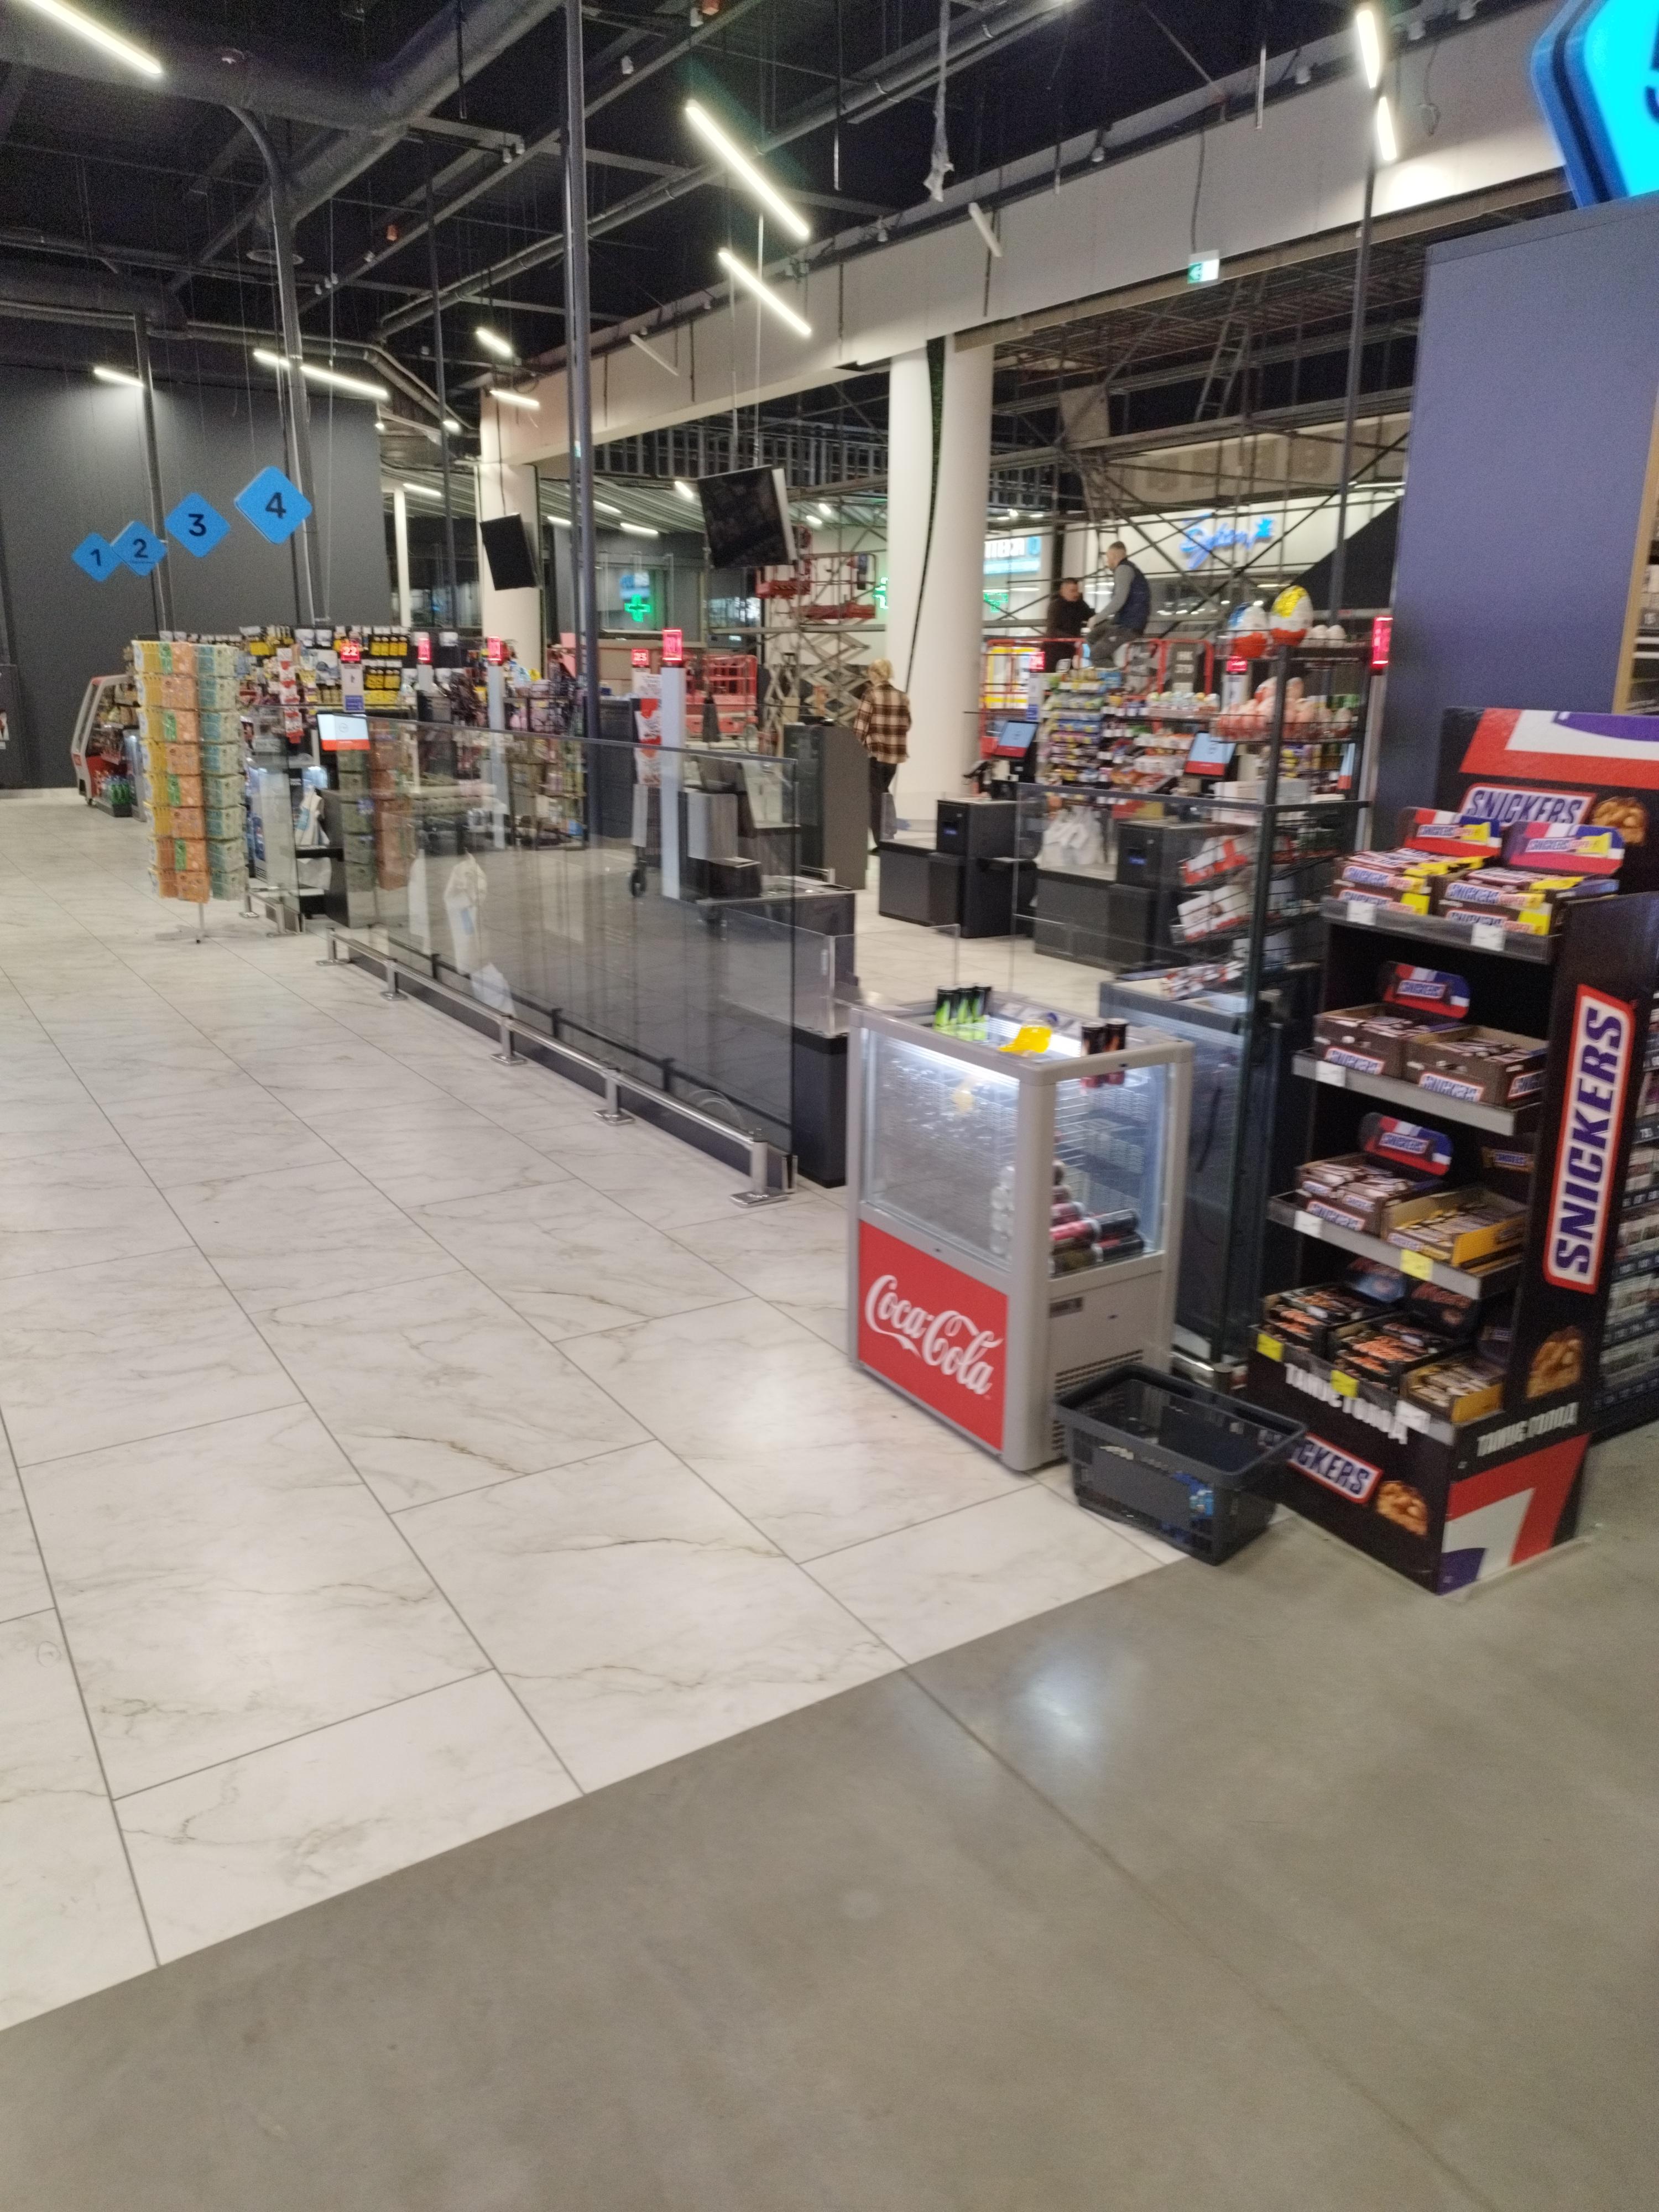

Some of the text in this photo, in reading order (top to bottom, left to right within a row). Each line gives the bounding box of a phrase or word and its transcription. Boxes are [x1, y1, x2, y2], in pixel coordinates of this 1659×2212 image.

[265, 492, 287, 519] 4
[188, 514, 207, 537] 3
[90, 549, 102, 566] 1
[133, 539, 149, 559] 2
[343, 646, 357, 656] 22
[1468, 789, 1583, 824] SNICKERS
[1556, 1006, 1623, 1274] SNICKERS
[864, 1274, 1004, 1395] Coca-Cola
